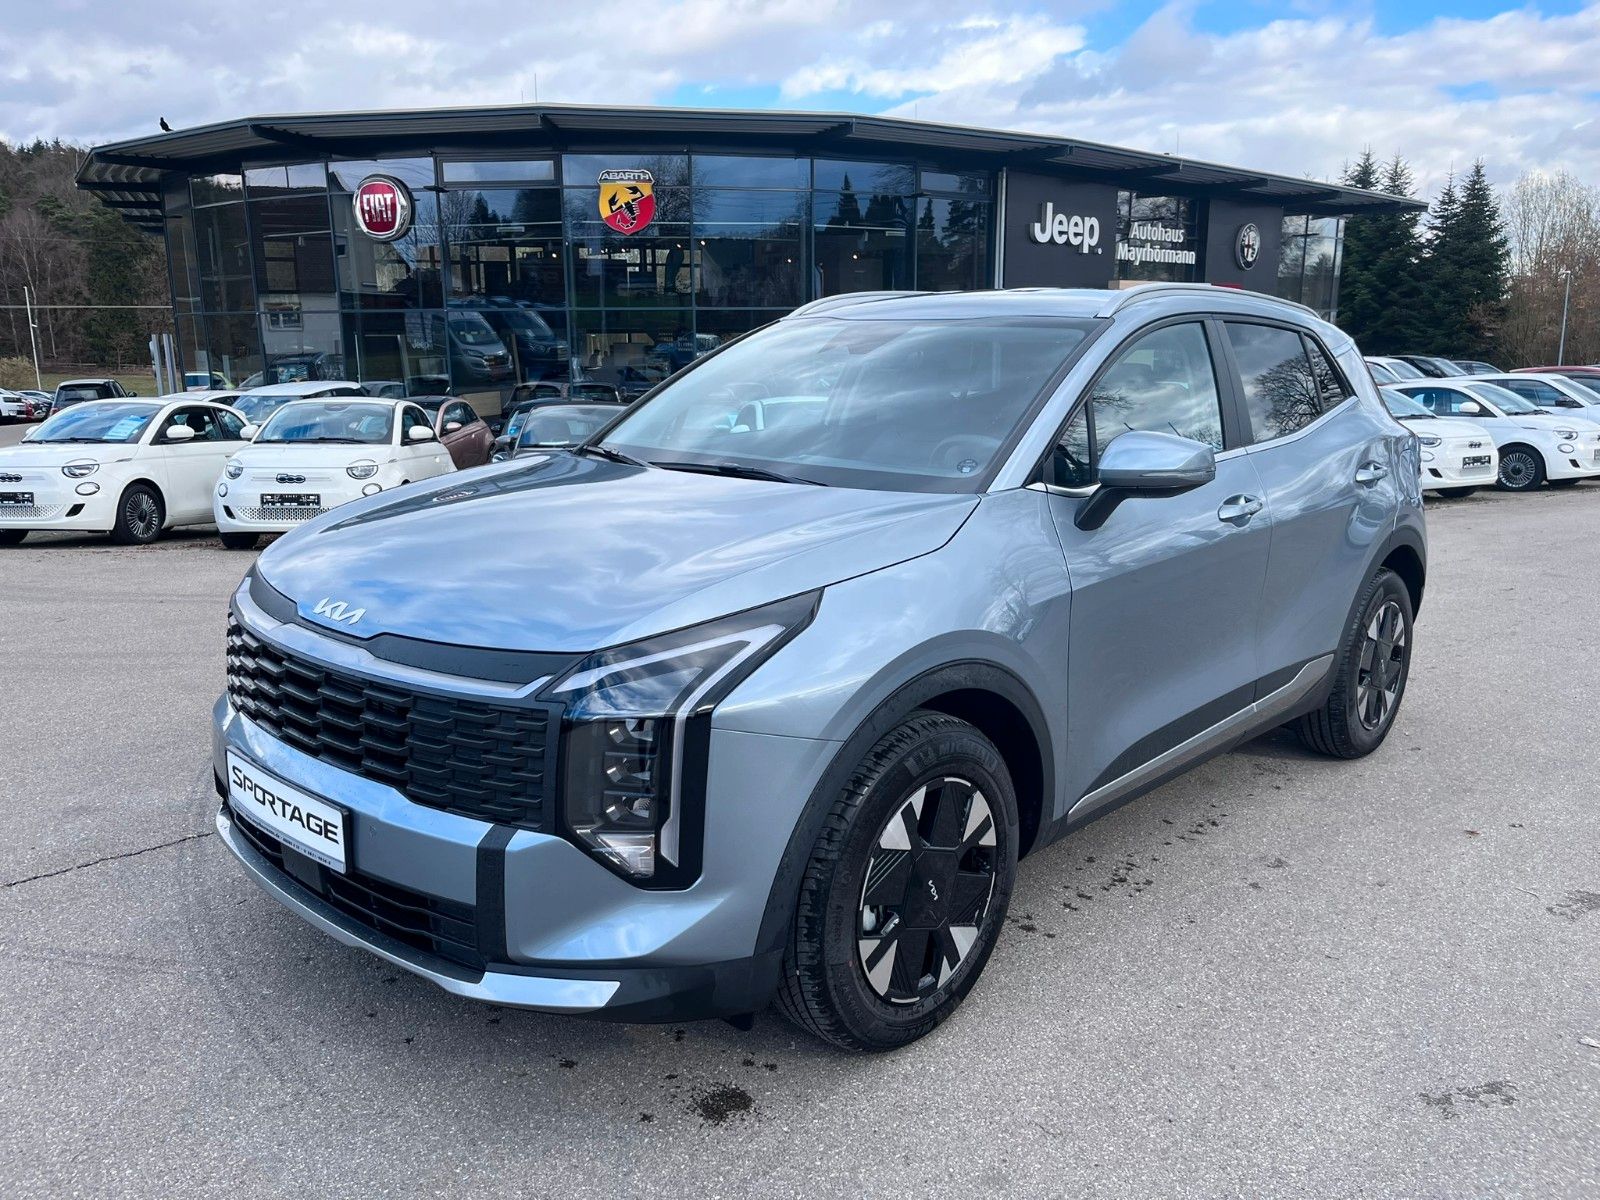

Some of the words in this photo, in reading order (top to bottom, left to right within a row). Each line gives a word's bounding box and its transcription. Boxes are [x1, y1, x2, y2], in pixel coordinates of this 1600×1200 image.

[601, 172, 649, 180] ABARTH
[362, 193, 393, 223] FIAT
[1034, 201, 1101, 254] Jeep
[1129, 221, 1184, 243] Autohaus
[1116, 242, 1196, 266] Mayrhörmann
[232, 764, 340, 845] SPORTAGE
